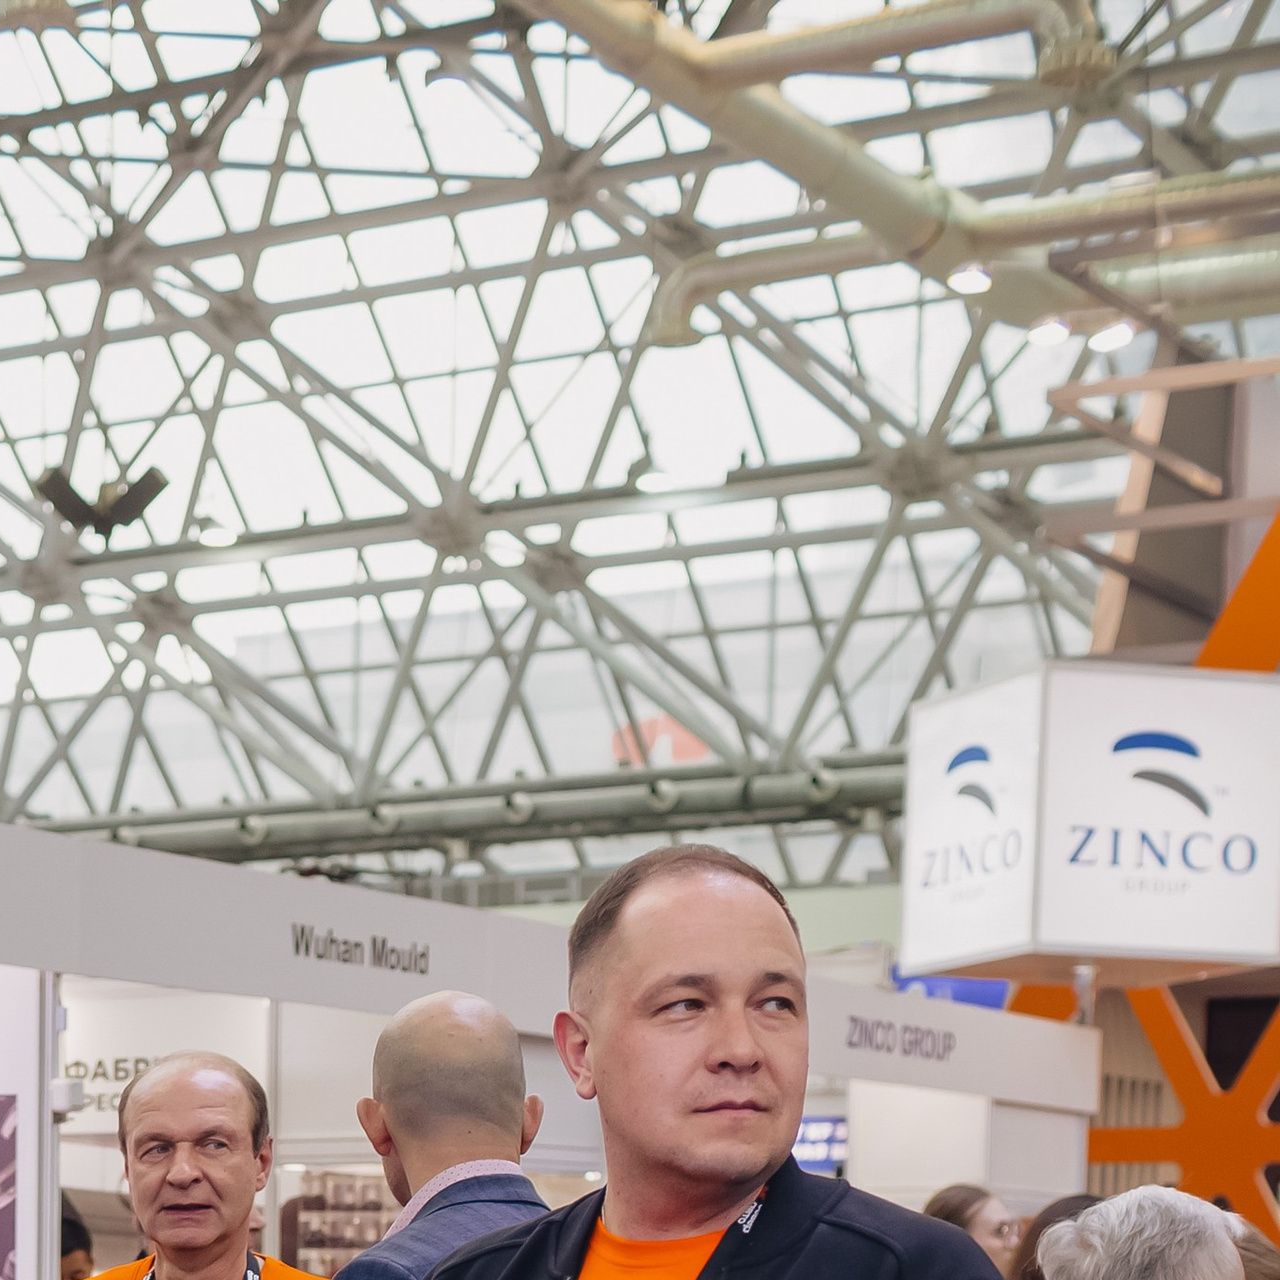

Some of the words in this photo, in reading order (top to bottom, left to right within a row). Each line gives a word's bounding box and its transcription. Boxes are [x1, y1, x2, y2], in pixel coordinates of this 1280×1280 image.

[921, 829, 1023, 888] ZINCO
[1068, 824, 1259, 876] ZINCO
[291, 921, 365, 966] Wuhan
[370, 935, 431, 975] Mould
[846, 1014, 898, 1055] ZINCO
[901, 1024, 957, 1062] GROUP
